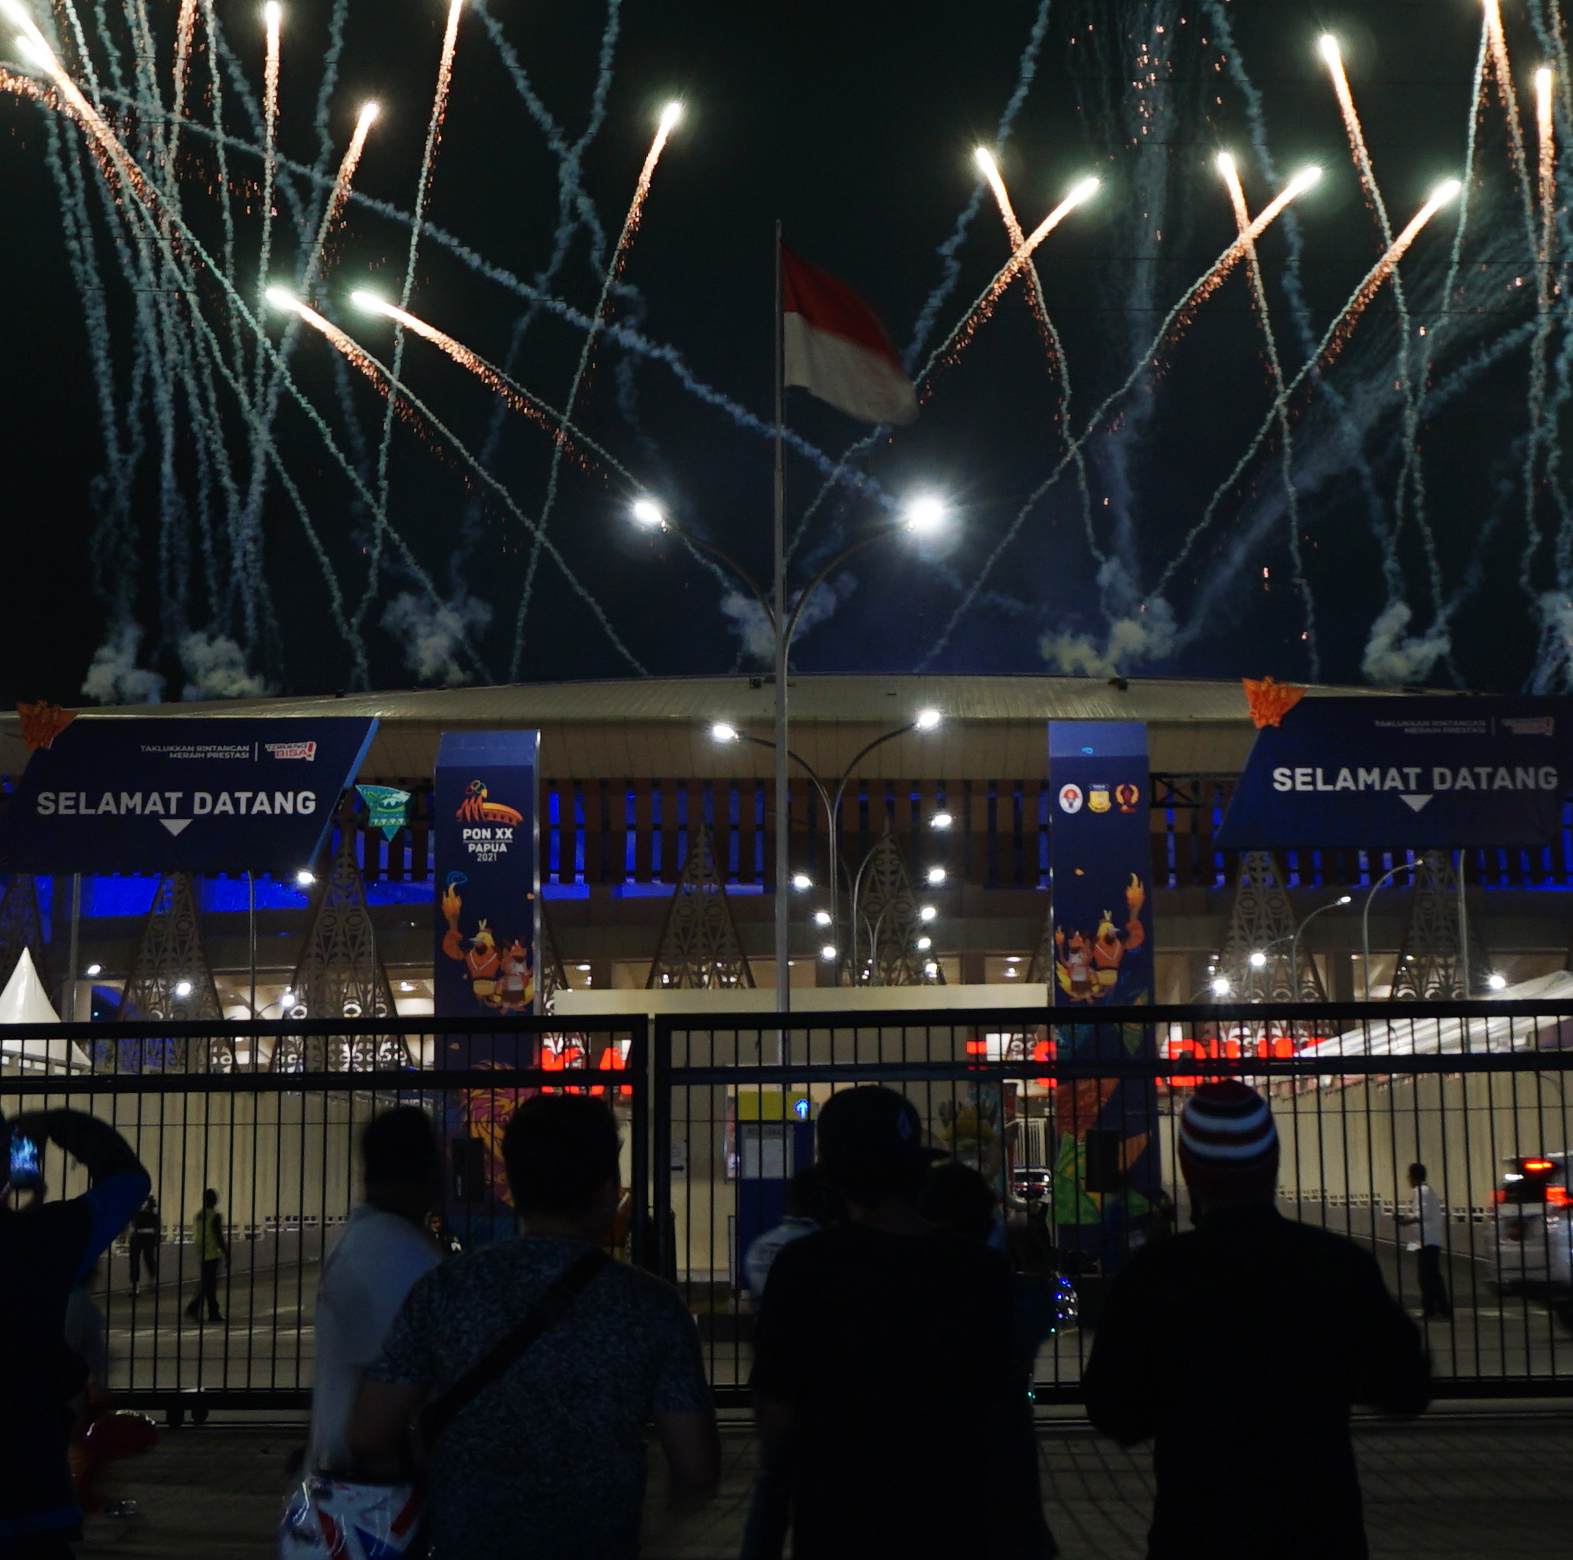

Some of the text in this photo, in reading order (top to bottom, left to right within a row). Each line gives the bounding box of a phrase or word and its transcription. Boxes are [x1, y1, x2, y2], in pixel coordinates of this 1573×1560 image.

[1273, 765, 1560, 791] SELAMAT DATANG
[36, 791, 317, 816] SELAMAT DATANG
[463, 828, 513, 839] PON XX
[468, 843, 507, 852] PAPUA
[477, 853, 497, 861] 2021
